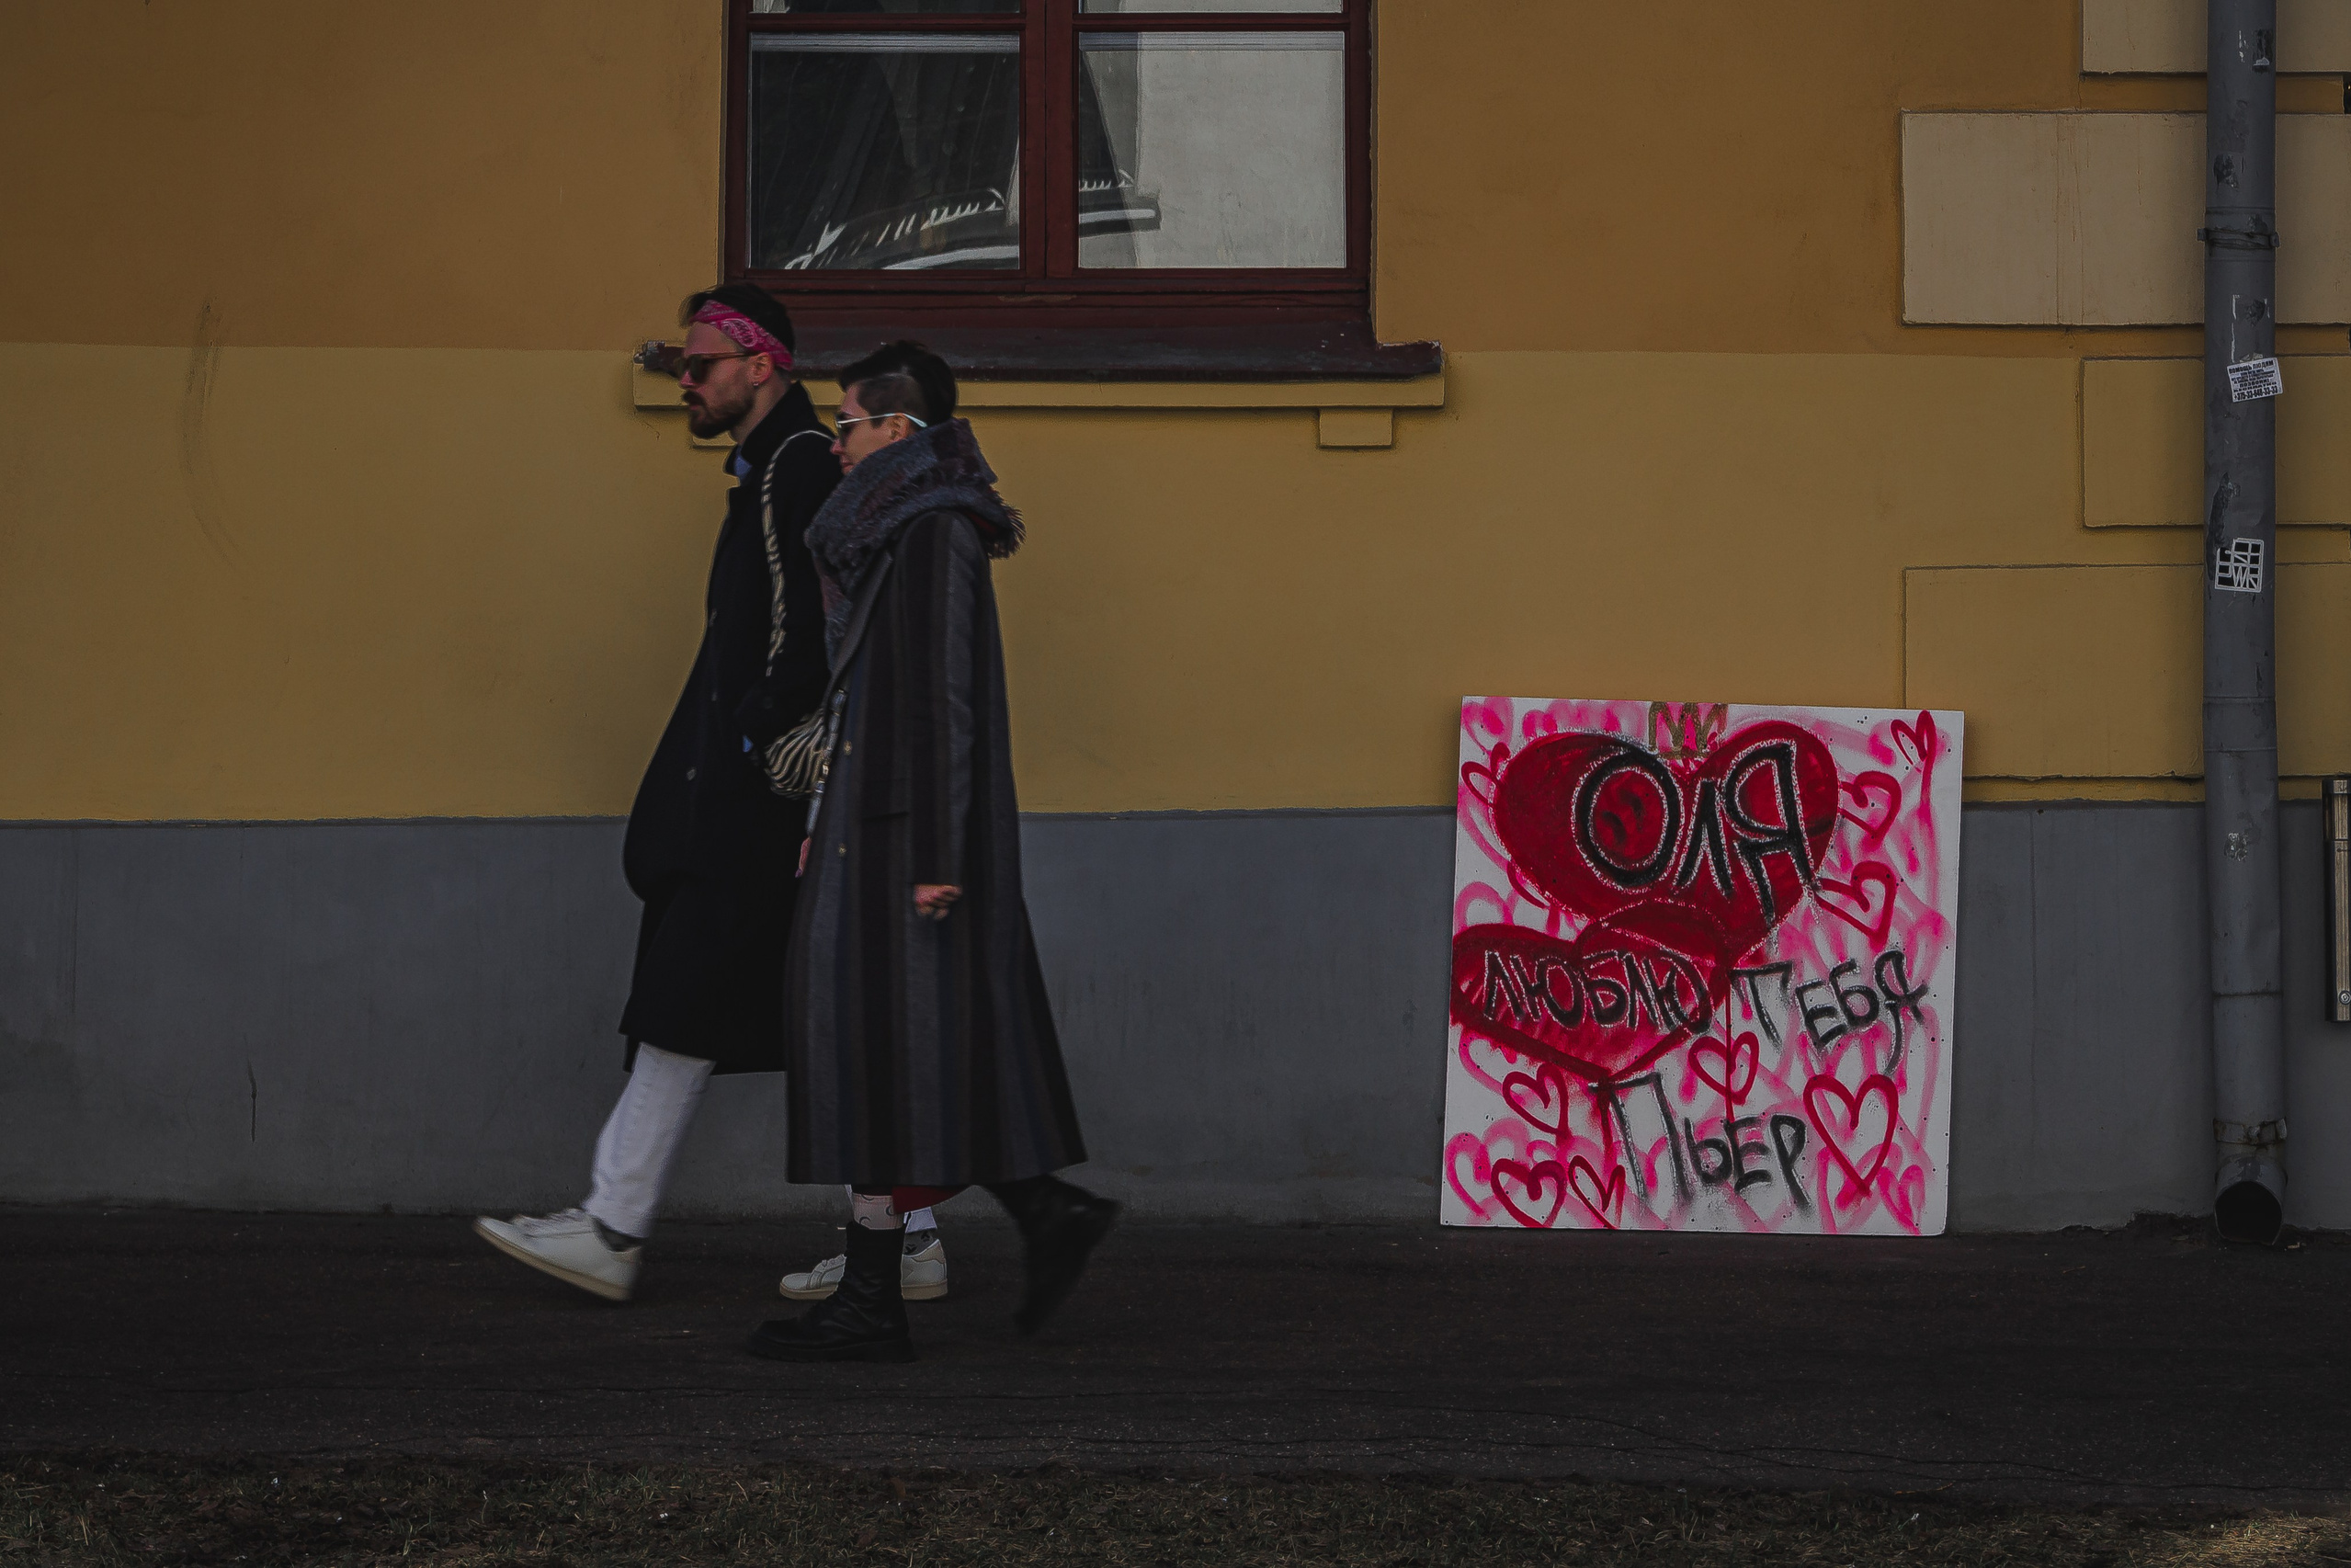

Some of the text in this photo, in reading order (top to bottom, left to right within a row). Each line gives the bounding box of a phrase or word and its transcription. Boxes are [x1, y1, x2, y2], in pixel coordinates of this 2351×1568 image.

[1573, 738, 1820, 928] ОЛЯ
[1483, 949, 1928, 1075] ЛЮБЛЮ ТЕБЯ
